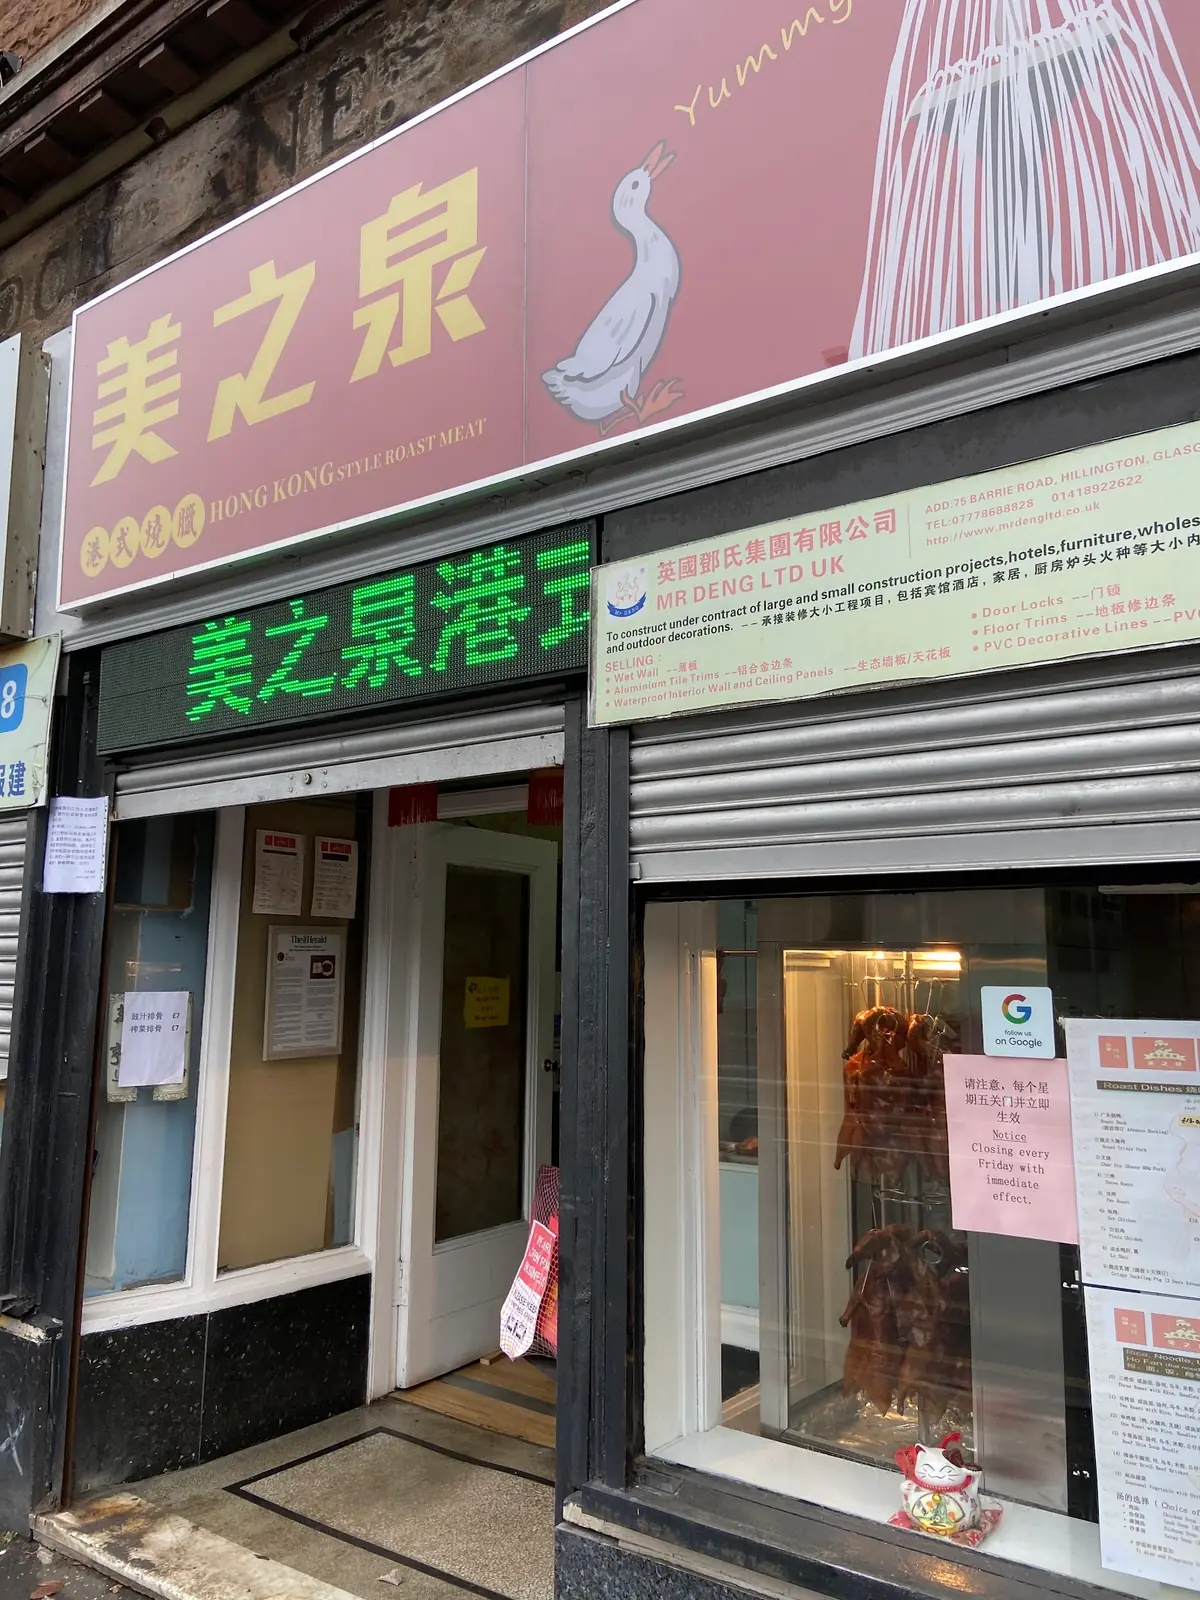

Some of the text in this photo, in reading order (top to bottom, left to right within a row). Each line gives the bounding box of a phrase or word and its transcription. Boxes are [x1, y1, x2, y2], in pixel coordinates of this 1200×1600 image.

[89, 167, 487, 488] 美之泉
[210, 418, 487, 523] HONG KONG STYLE ROAST MEAT
[925, 496, 966, 514] ADD:75
[970, 486, 1013, 503] BARRIE
[926, 475, 1142, 530] TEL:07778688828 01418922622
[926, 502, 1100, 546] http://www.mrdengltd.co.uk
[657, 508, 896, 585] 英國鄧氏集團有限公司
[657, 555, 844, 611] MR DENG LTD UK
[607, 632, 618, 642] To
[621, 621, 667, 639] construct
[670, 616, 700, 630] under
[702, 605, 747, 622] contract
[750, 603, 761, 613] of
[763, 598, 792, 612] large
[796, 590, 818, 604] and
[821, 583, 855, 600] small
[858, 568, 942, 592] construction
[983, 604, 1016, 618] Door
[1021, 596, 1063, 611] Locks
[984, 622, 1021, 635] Floor
[1025, 614, 1067, 628] Trims
[984, 638, 1013, 652] PVC
[1017, 627, 1100, 646] Decorative
[1105, 619, 1148, 633] Lines
[607, 642, 624, 655] and
[627, 636, 666, 651] outdoor
[668, 622, 734, 643] decorations.
[613, 673, 634, 683] Wet
[637, 668, 658, 680] Wall
[614, 681, 666, 695] Aluminium
[669, 677, 687, 686] Tile
[690, 671, 719, 684] Trims
[1, 680, 17, 718] 8
[614, 692, 666, 708] Waterproof
[669, 688, 705, 700] Interior
[708, 682, 730, 693] Wall
[733, 679, 752, 690] and
[756, 672, 793, 686] Ceiling
[796, 667, 833, 680] Panels
[1008, 1037, 1042, 1049] Google
[1103, 1082, 1139, 1090] Roast
[1141, 1084, 1182, 1093] Dishes
[965, 1094, 1050, 1110] 期五关门并立即
[996, 1111, 1021, 1124] 生效
[992, 1129, 1027, 1140] Notice
[972, 1143, 1050, 1160] Closing every
[978, 1159, 1044, 1175] Friday with
[986, 1174, 1039, 1190] immediate
[993, 1191, 1032, 1205] effect.
[1161, 1501, 1188, 1513] Choice
